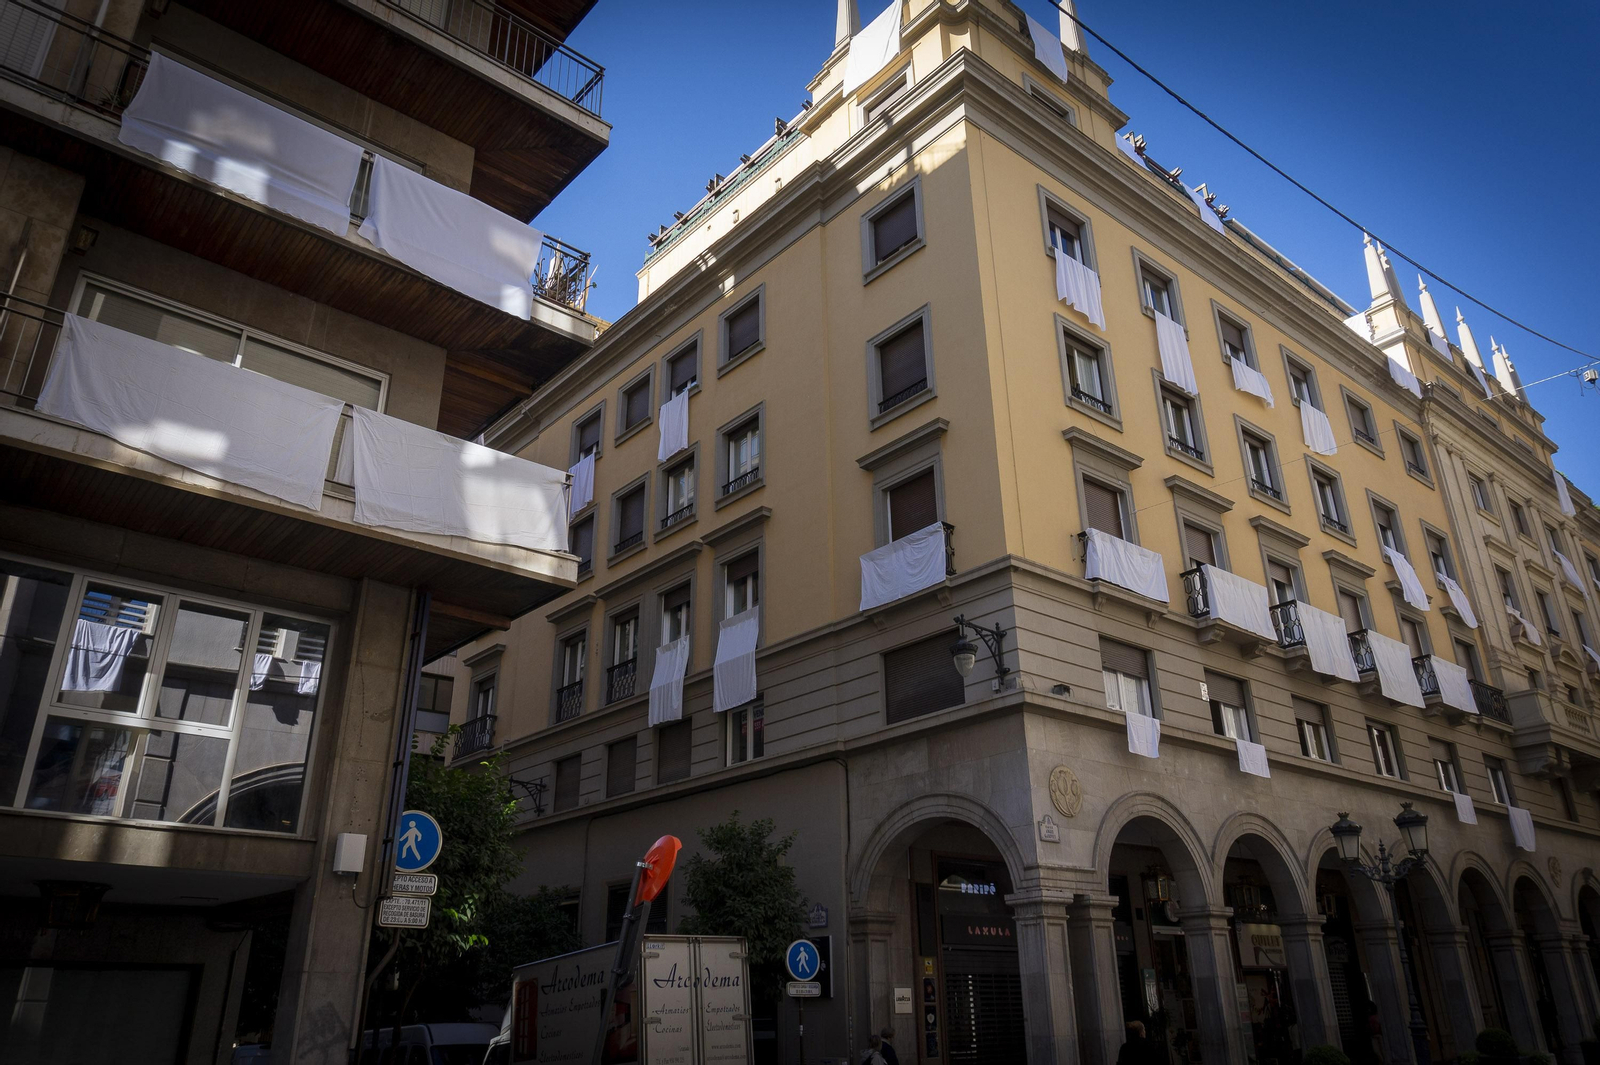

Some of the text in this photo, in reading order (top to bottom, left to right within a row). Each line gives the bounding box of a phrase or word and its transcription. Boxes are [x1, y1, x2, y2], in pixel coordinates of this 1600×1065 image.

[408, 876, 428, 884] ACCESO
[541, 964, 604, 995] Arcodema
[653, 962, 740, 989] Arcodema
